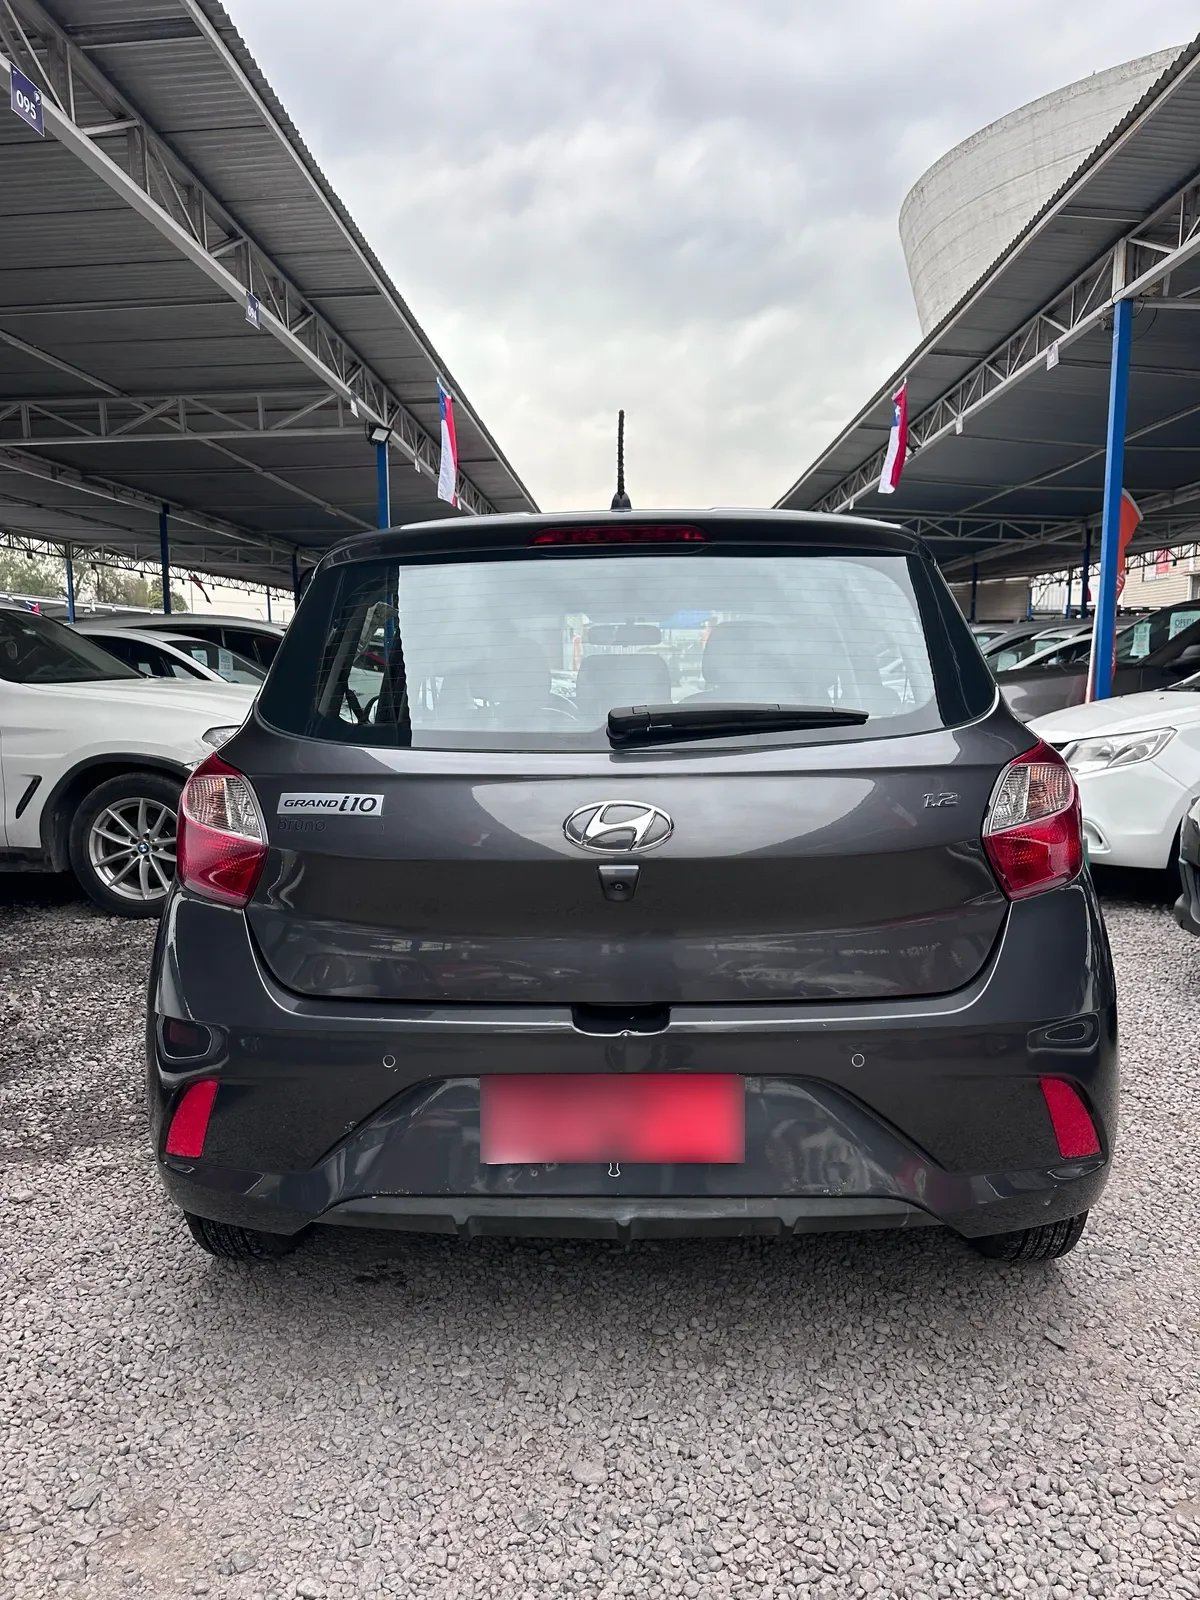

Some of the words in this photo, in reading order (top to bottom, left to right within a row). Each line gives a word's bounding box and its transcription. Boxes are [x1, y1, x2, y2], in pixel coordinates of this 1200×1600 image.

[16, 89, 37, 120] 095
[283, 799, 338, 808] GRAND
[338, 795, 378, 812] i10
[923, 792, 959, 809] 1.2
